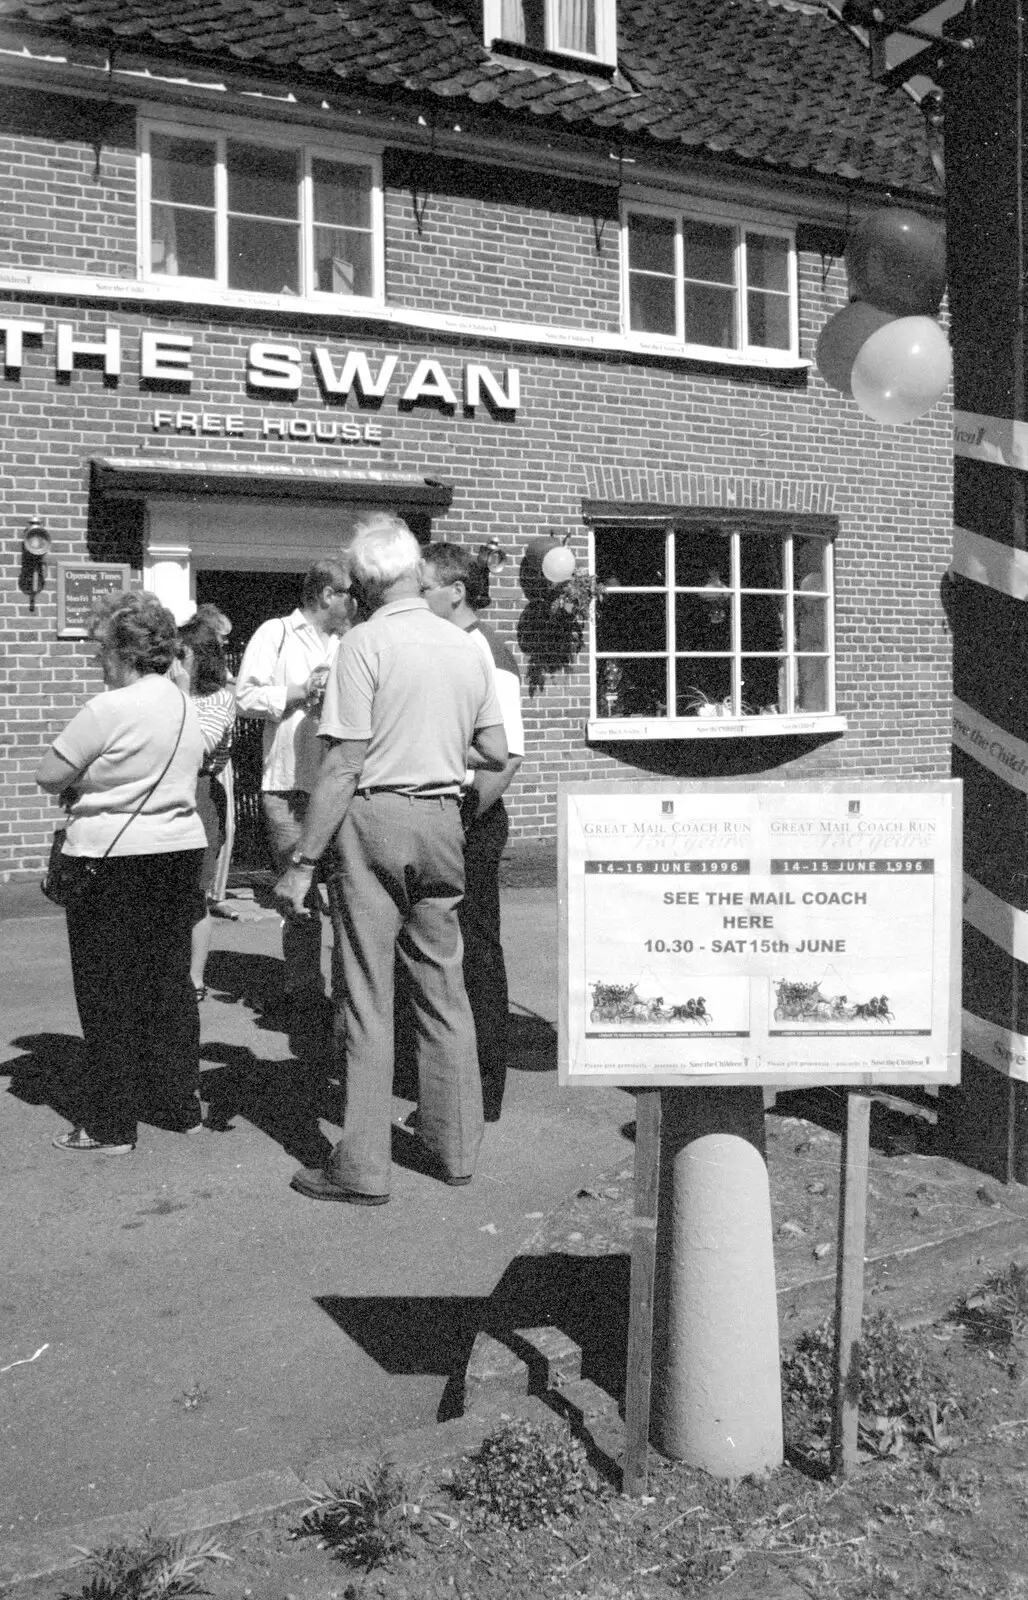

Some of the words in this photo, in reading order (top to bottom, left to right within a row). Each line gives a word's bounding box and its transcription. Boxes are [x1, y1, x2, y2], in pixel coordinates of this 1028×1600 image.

[0, 319, 194, 381] THE
[248, 342, 521, 409] SWAN
[154, 410, 244, 433] FREE
[263, 416, 383, 441] HOUSE
[65, 571, 98, 581] Opening
[100, 571, 122, 581] Times
[653, 862, 691, 873] JUNE
[701, 862, 738, 872] 1996
[837, 861, 876, 872] JUNE
[886, 861, 923, 872] 1996
[663, 892, 700, 905] SEE
[705, 892, 743, 905] THE
[749, 892, 796, 905] MAIL
[801, 892, 868, 905] COACH
[722, 916, 774, 929] HERE
[643, 939, 694, 953] 10.30
[711, 939, 748, 953] SAT
[749, 939, 790, 953] 15th
[795, 939, 847, 953] JUNE
